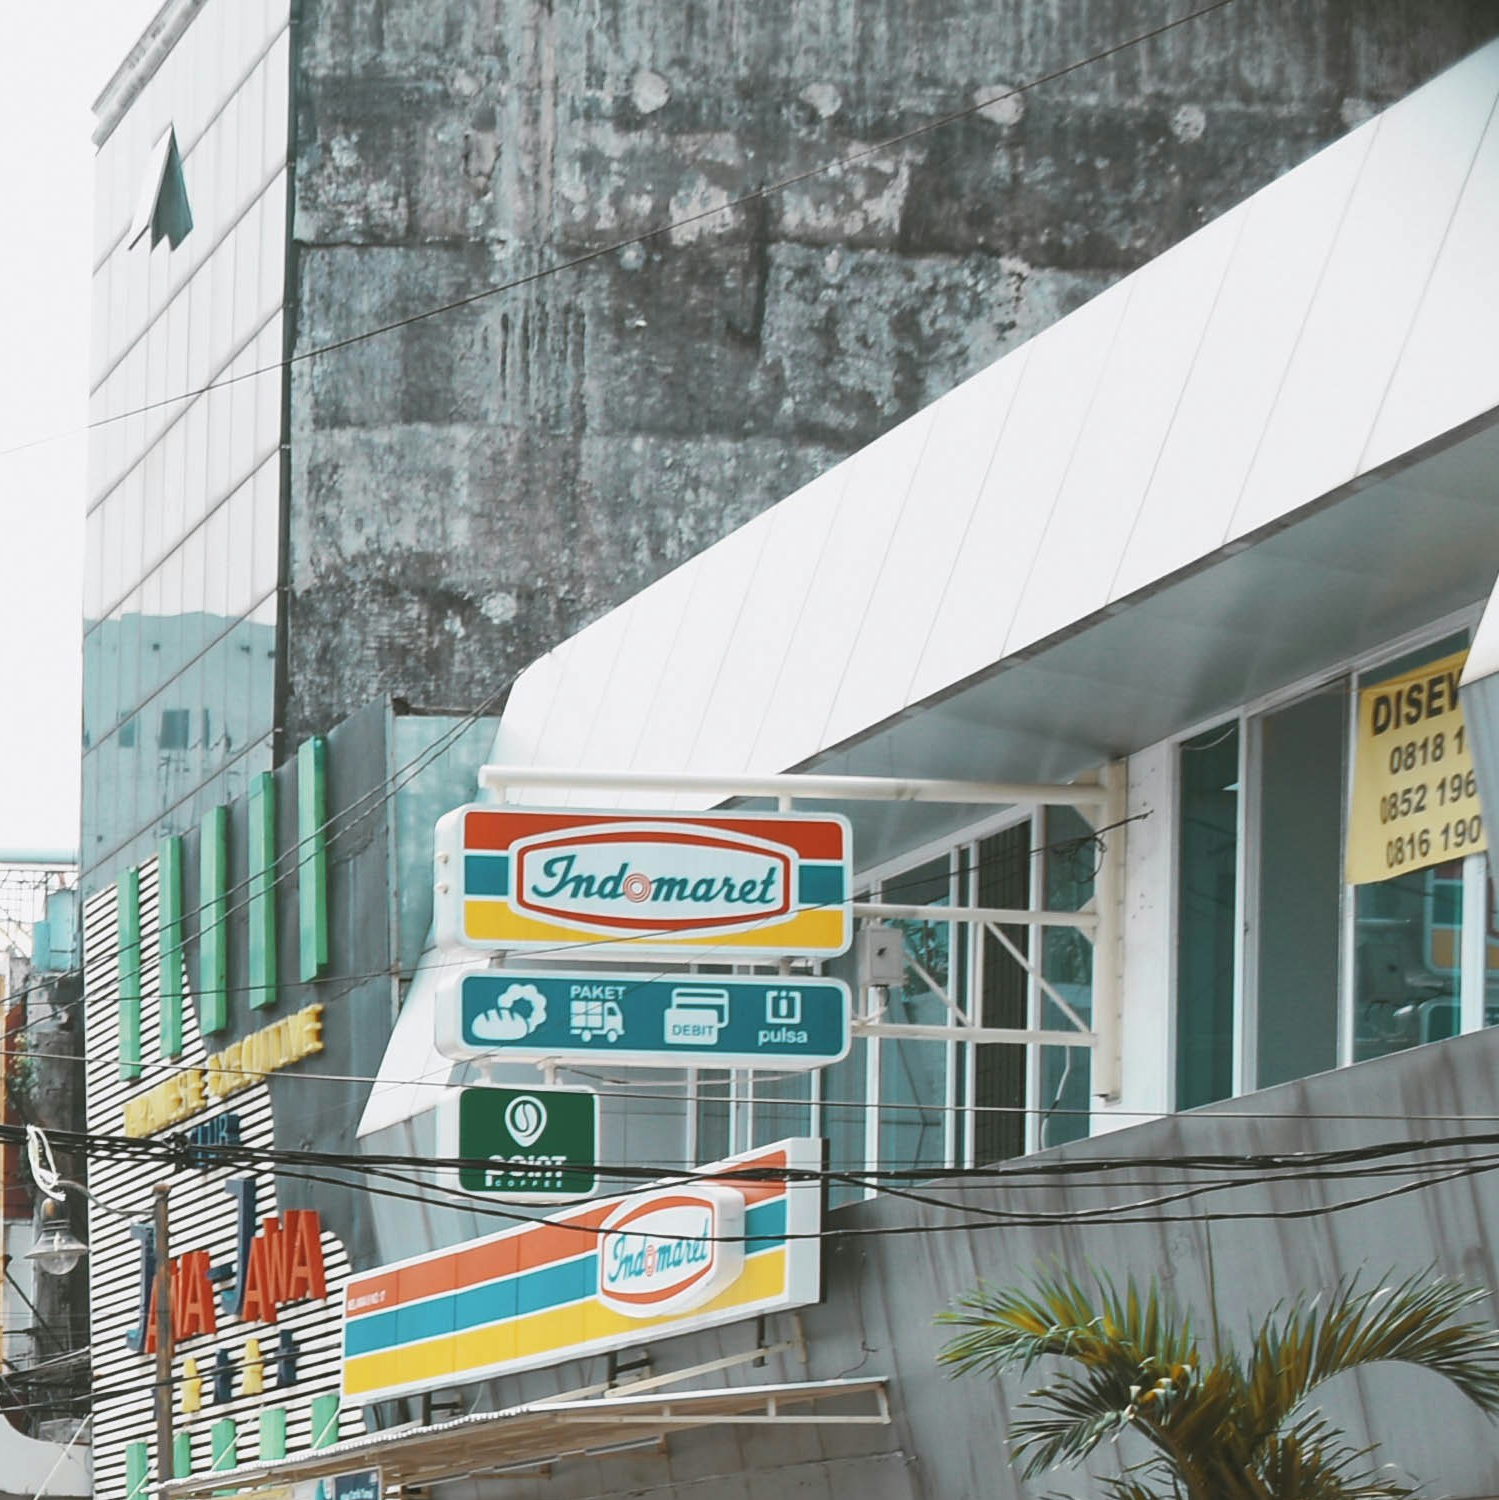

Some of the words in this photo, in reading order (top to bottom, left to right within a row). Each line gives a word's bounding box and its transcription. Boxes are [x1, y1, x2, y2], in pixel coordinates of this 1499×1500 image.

[1389, 732, 1446, 775] 0818
[1379, 783, 1428, 824] 0852
[1386, 828, 1431, 868] 0816
[531, 854, 777, 905] Indomaret
[570, 984, 627, 1000] PAKET
[672, 1023, 715, 1037] DEBIT
[758, 1028, 808, 1046] pulsa
[495, 1180, 563, 1188] COFFEE
[607, 1217, 709, 1283] Indomaret
